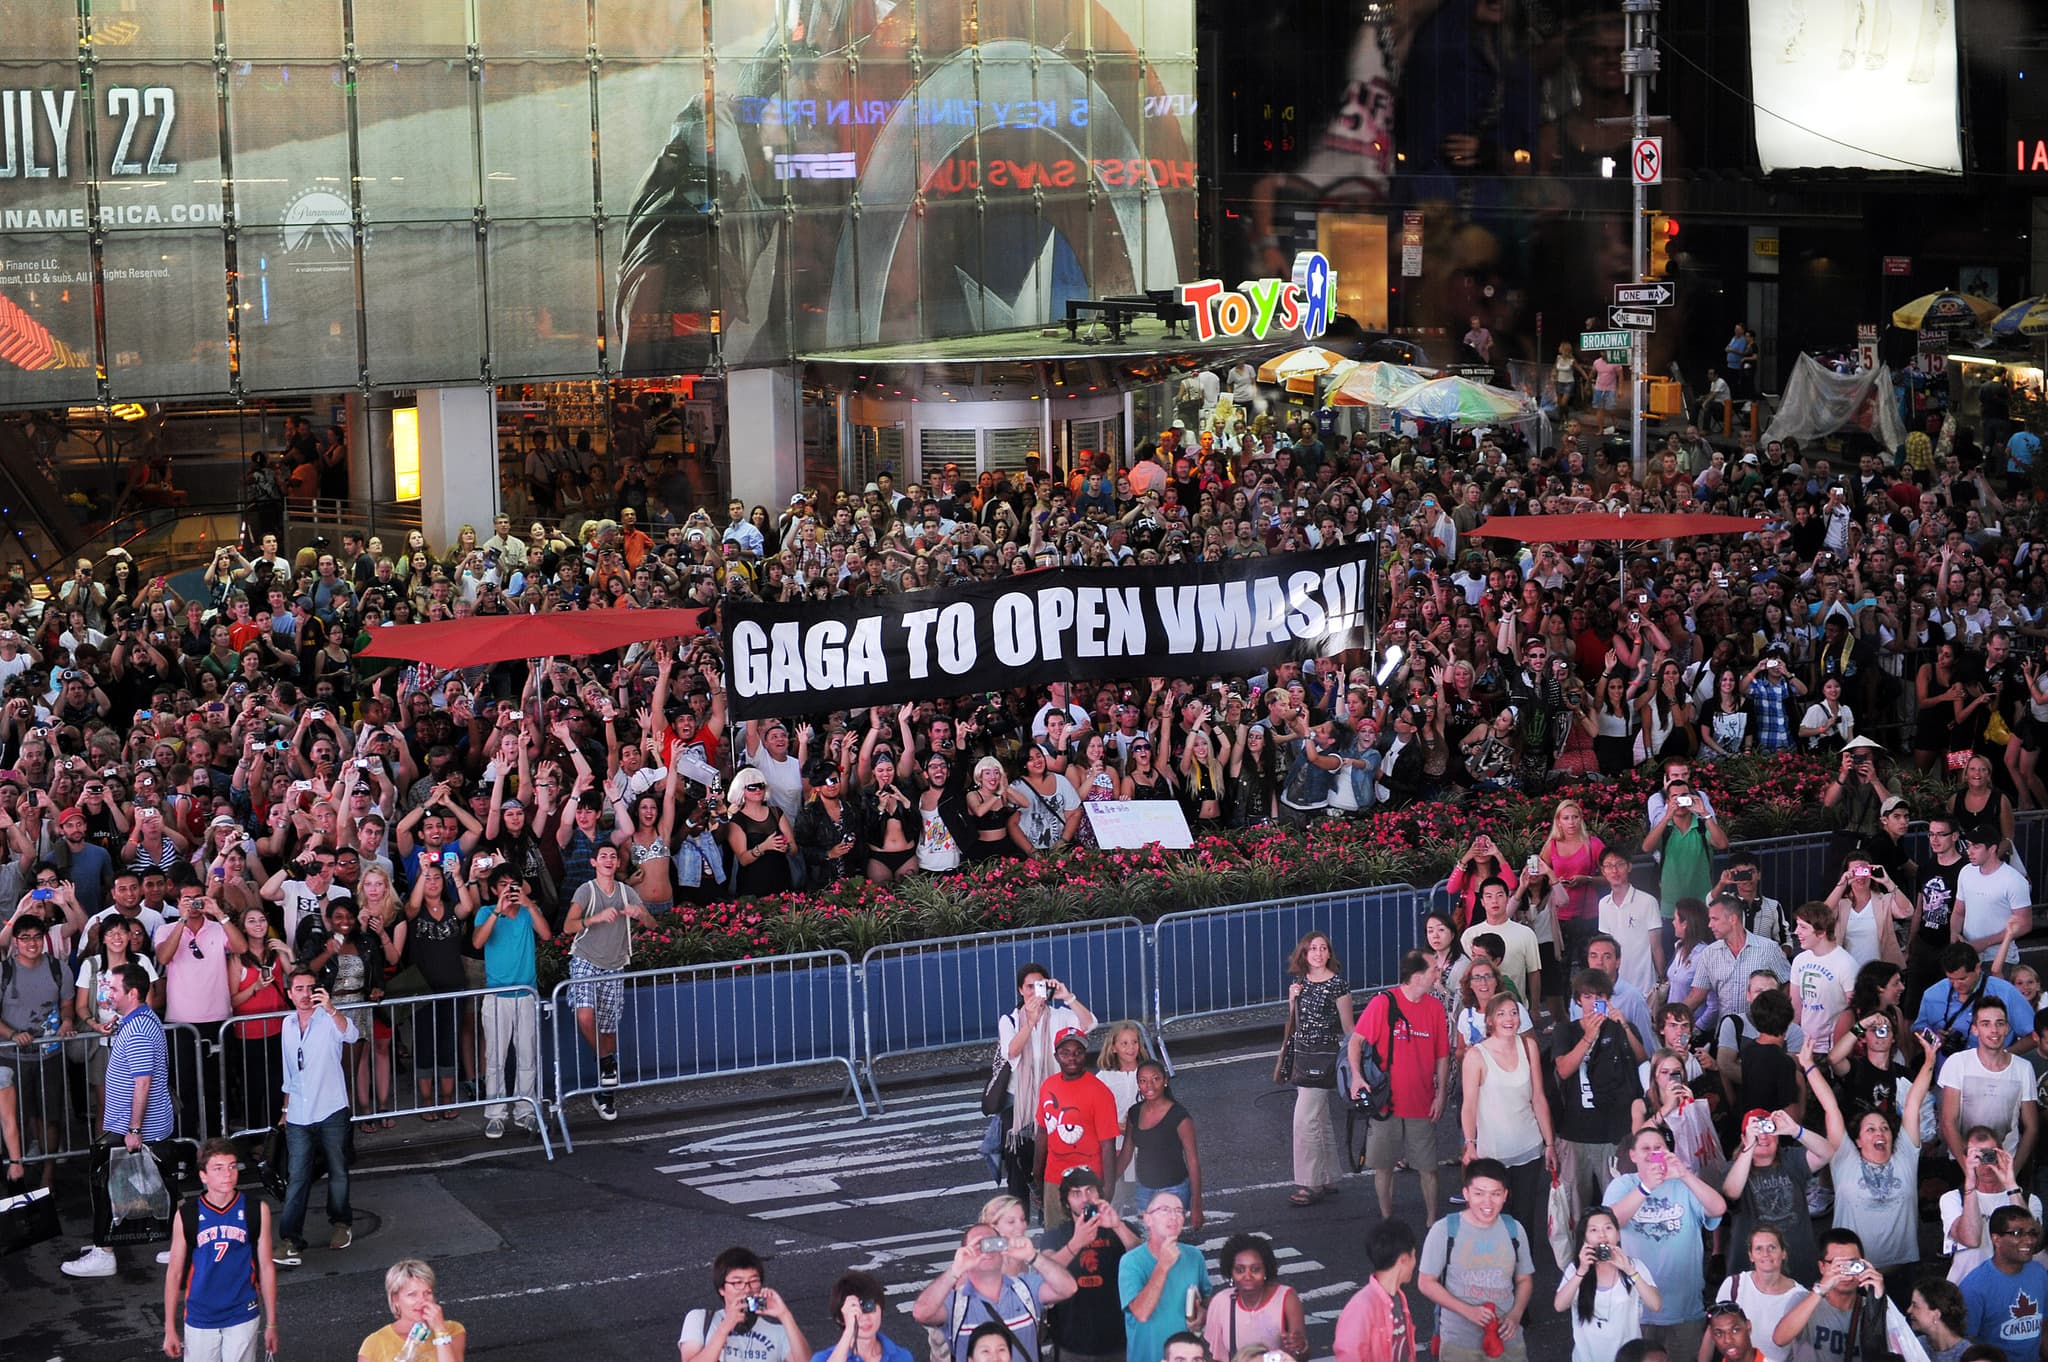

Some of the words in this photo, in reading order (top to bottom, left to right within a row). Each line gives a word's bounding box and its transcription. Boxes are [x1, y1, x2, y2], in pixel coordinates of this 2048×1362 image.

[108, 87, 178, 175] 22
[0, 203, 241, 229] NAMERICA.COM
[1623, 291, 1640, 300] ONE
[1648, 290, 1665, 299] WAY
[1616, 313, 1630, 322] ONE
[1636, 315, 1650, 323] WAY
[1857, 324, 1877, 337] SALE
[1583, 333, 1628, 348] BROADWAY
[732, 615, 888, 698] GAGA
[901, 601, 978, 680] TO
[992, 586, 1147, 667] OPEN
[1155, 559, 1368, 655] VMAS!!!
[220, 1225, 247, 1244] YORK
[214, 1242, 229, 1262] 7
